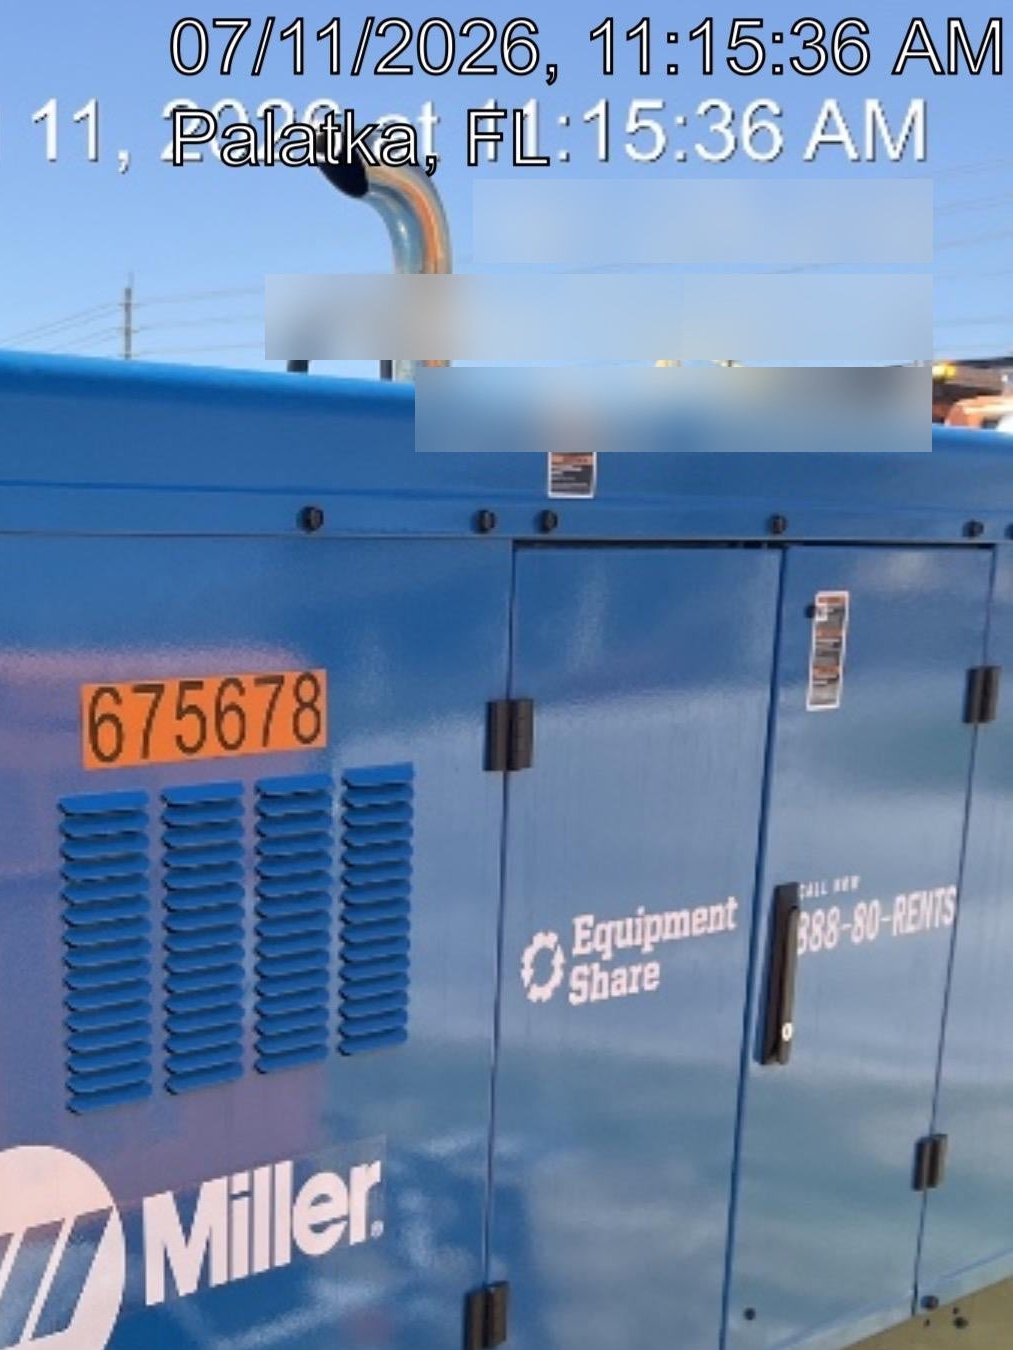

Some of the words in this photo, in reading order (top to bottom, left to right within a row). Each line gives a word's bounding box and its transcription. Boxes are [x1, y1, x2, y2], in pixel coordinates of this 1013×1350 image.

[89, 672, 321, 763] 675678
[571, 896, 738, 961] Equipment
[568, 961, 660, 1006] Share
